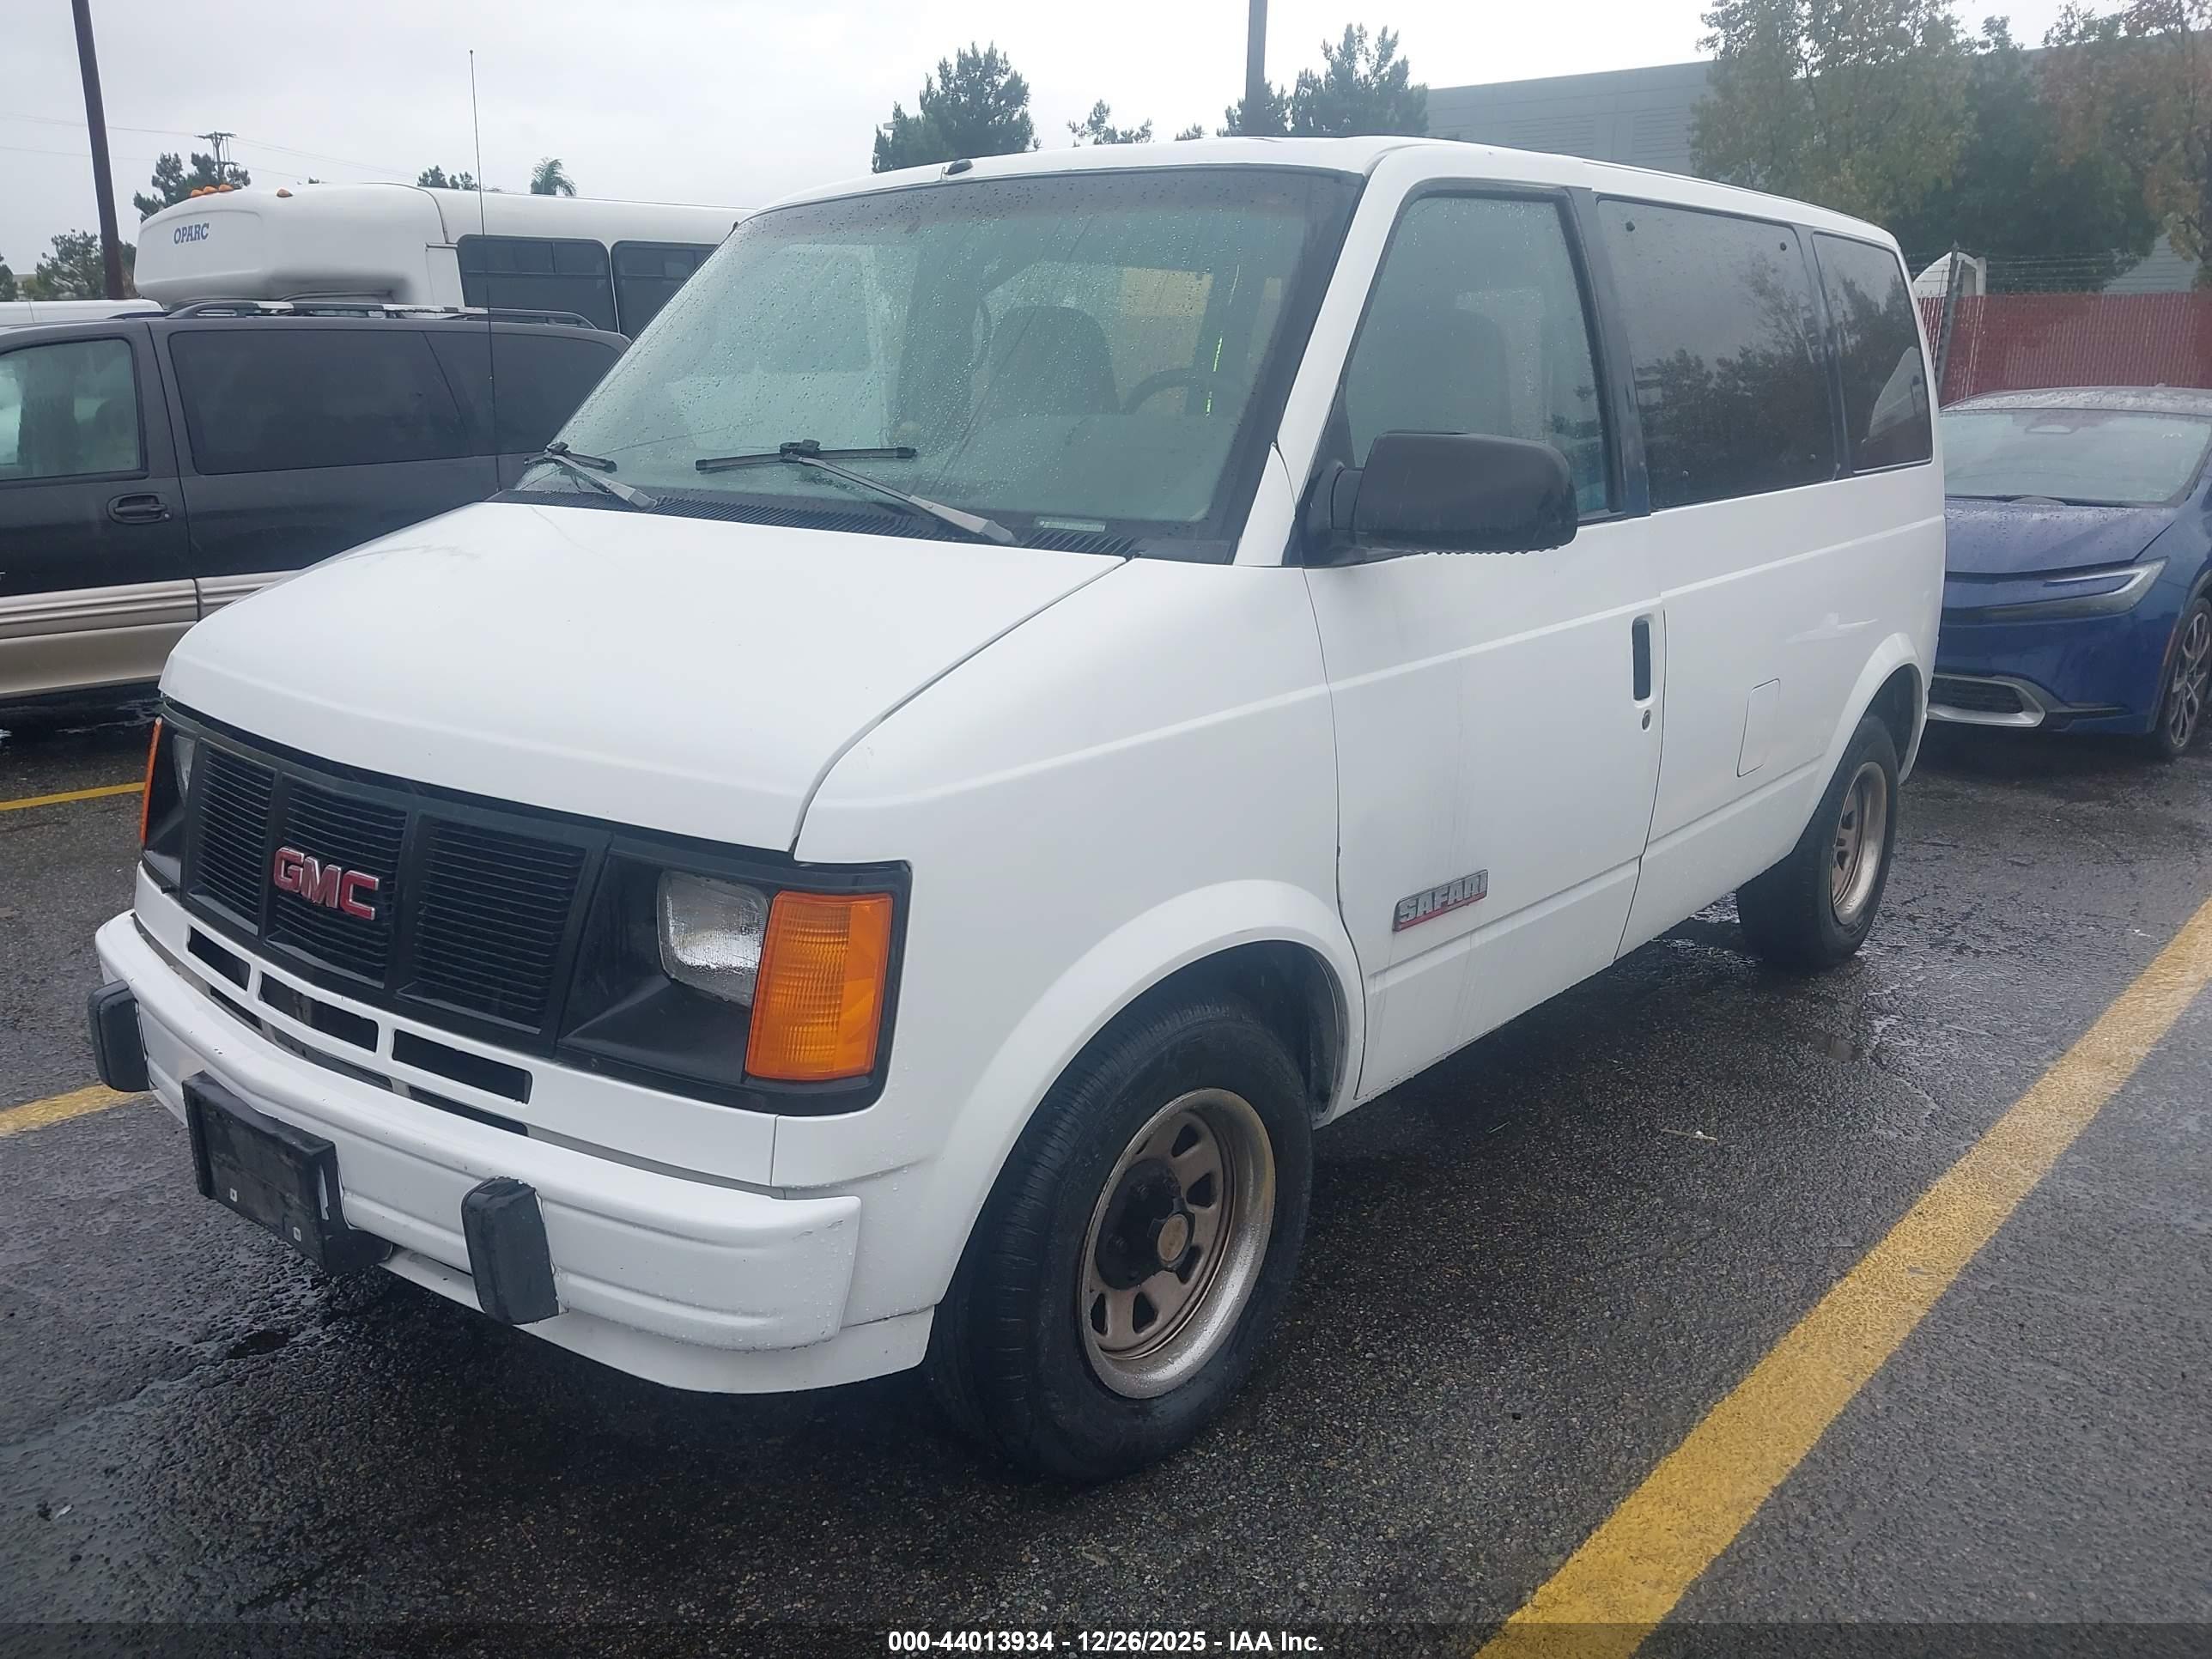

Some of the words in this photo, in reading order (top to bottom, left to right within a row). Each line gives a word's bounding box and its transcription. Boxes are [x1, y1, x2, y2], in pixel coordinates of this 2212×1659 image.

[173, 222, 210, 245] OPARC
[273, 847, 379, 921] GMC
[1396, 871, 1488, 924] SAFARI
